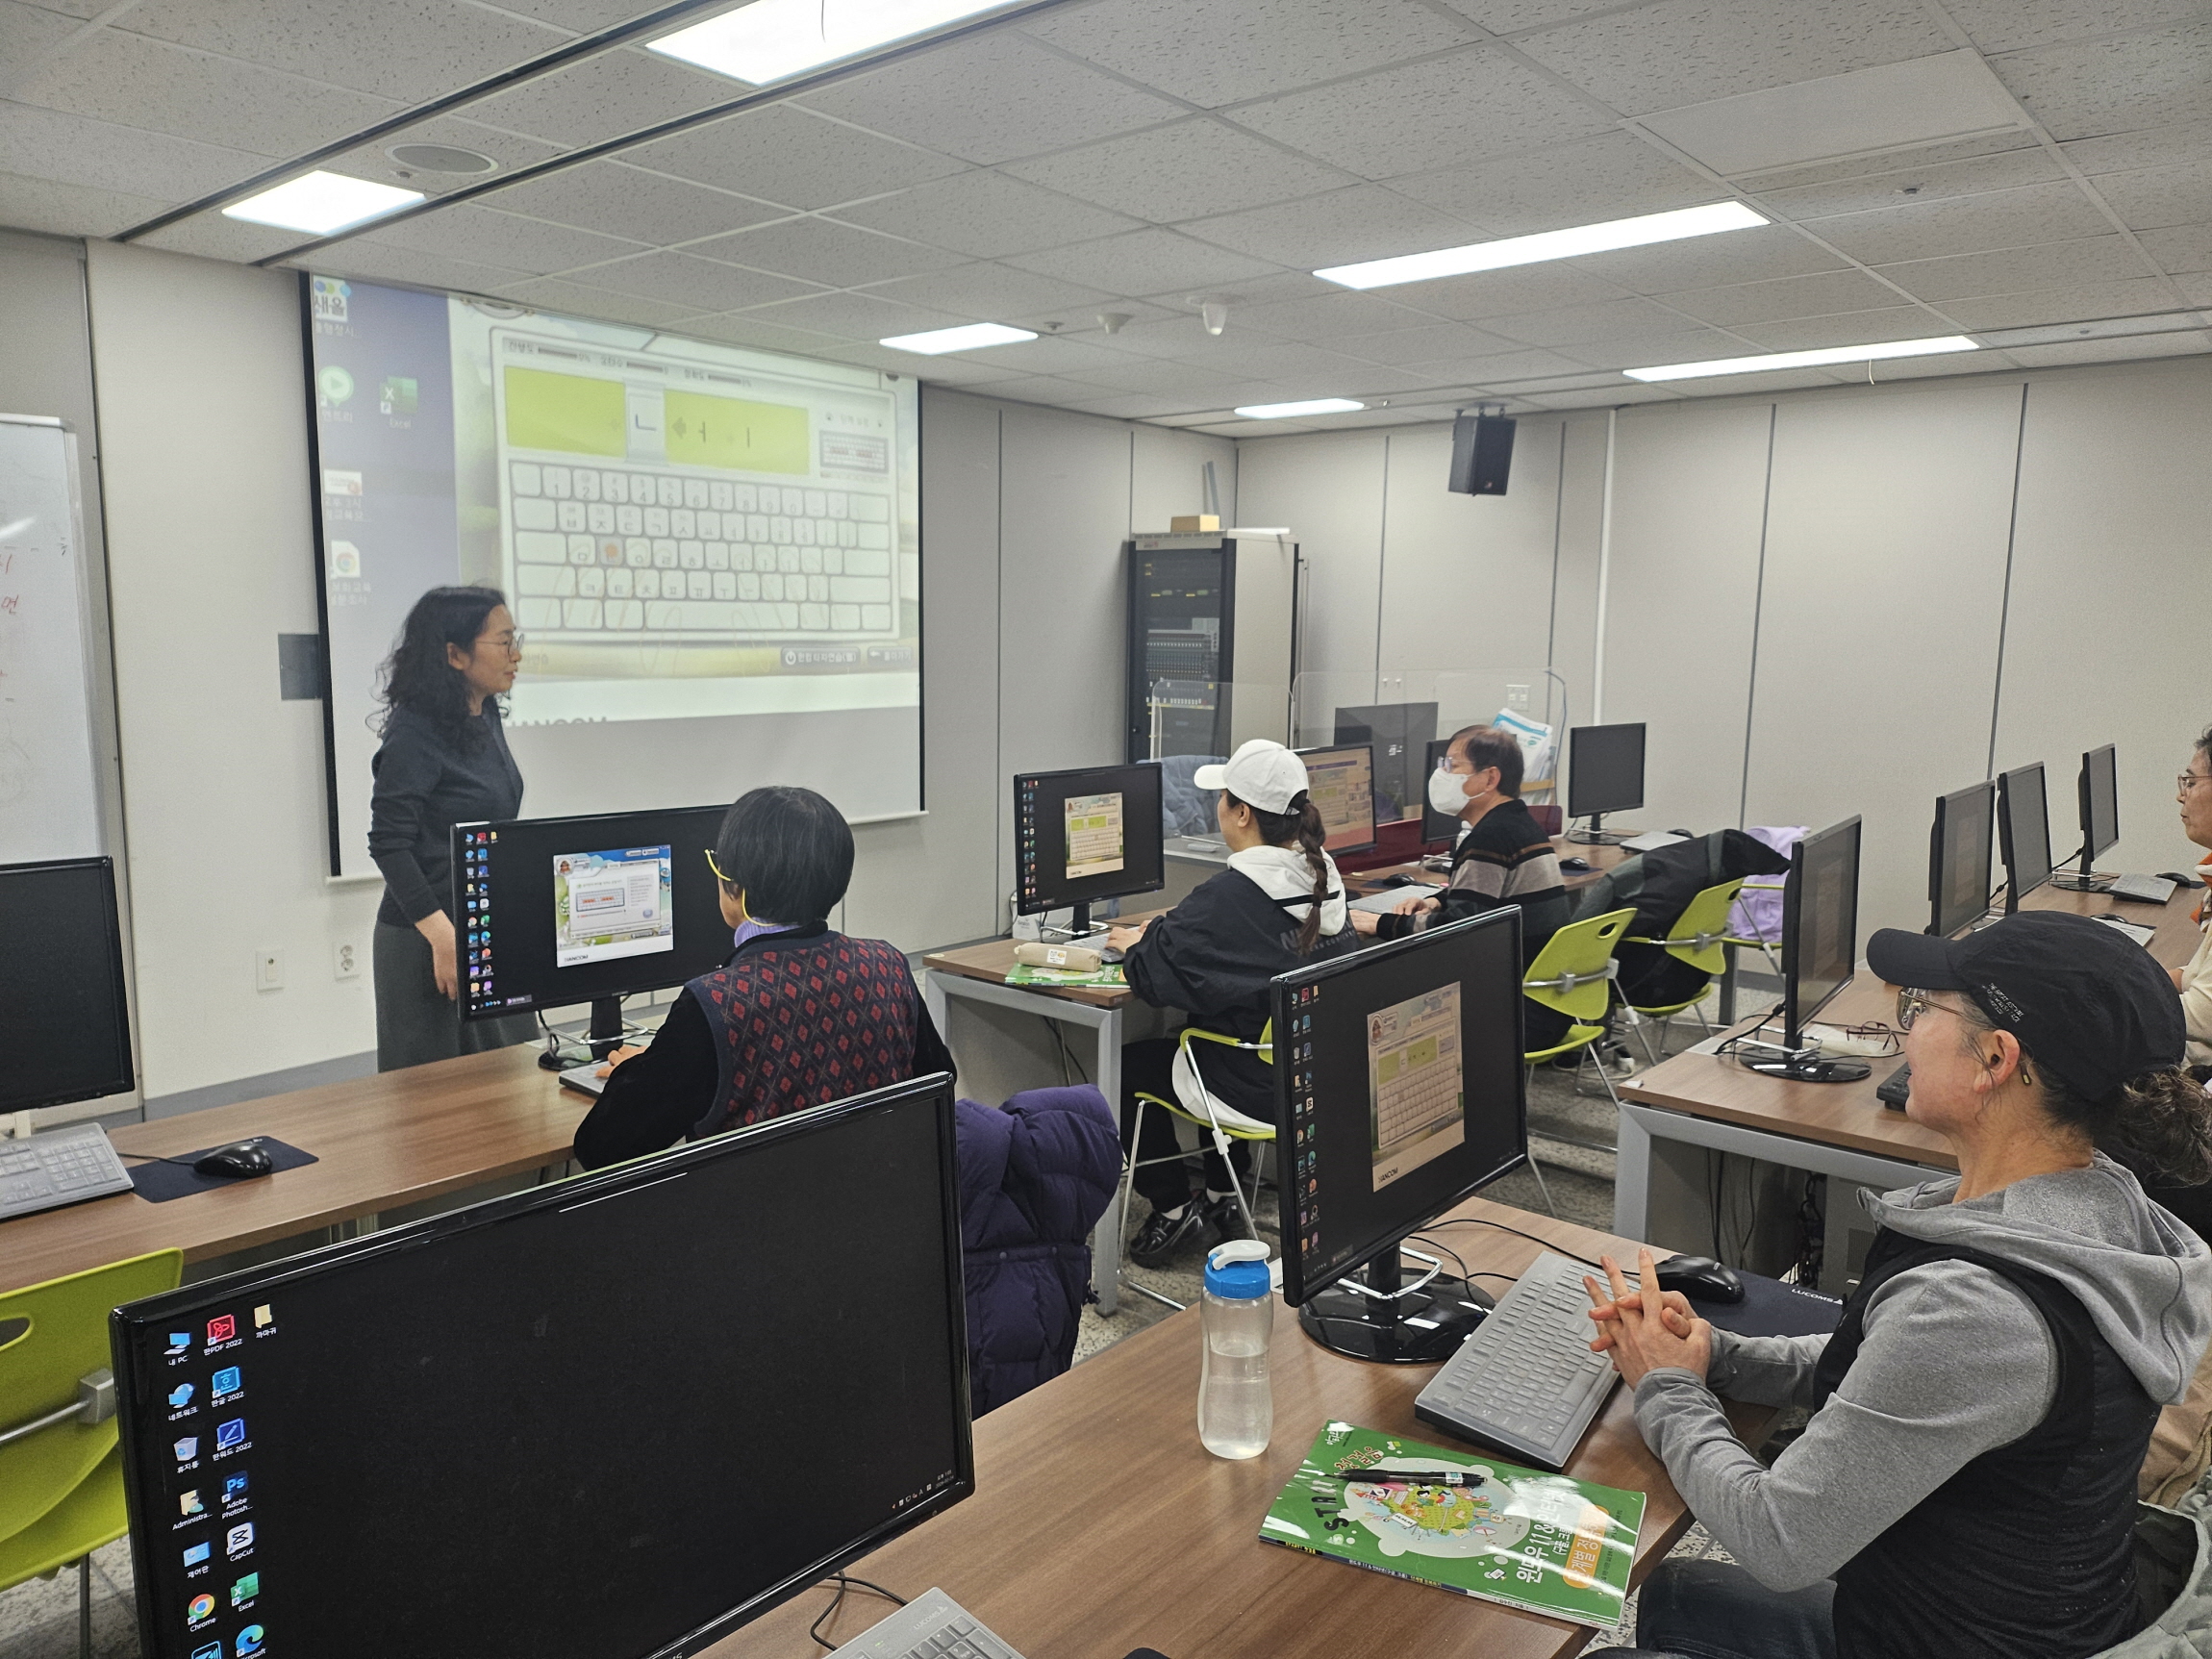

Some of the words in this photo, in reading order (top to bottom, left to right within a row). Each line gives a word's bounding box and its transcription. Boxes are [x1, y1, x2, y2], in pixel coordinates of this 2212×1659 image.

[1792, 1289, 1833, 1302] LUCOMS
[203, 1345, 224, 1356] 한PDF
[225, 1338, 243, 1349] 2022
[178, 1355, 189, 1364] PC
[211, 1397, 226, 1408] 한글
[227, 1391, 244, 1402] 2022
[167, 1406, 199, 1420] 네트워크
[213, 1448, 234, 1462] 한워드
[235, 1442, 253, 1453] 2022
[1334, 1445, 1383, 1471] 첫걸음
[176, 1460, 199, 1473] 휴지통
[226, 1477, 245, 1493] Ps
[226, 1497, 247, 1510] Adobe
[230, 1547, 254, 1562] CapCut
[1516, 1546, 1549, 1583] 윈도우
[187, 1565, 210, 1579] 제어판
[238, 1599, 255, 1612] Excel
[189, 1618, 216, 1632] Chrome
